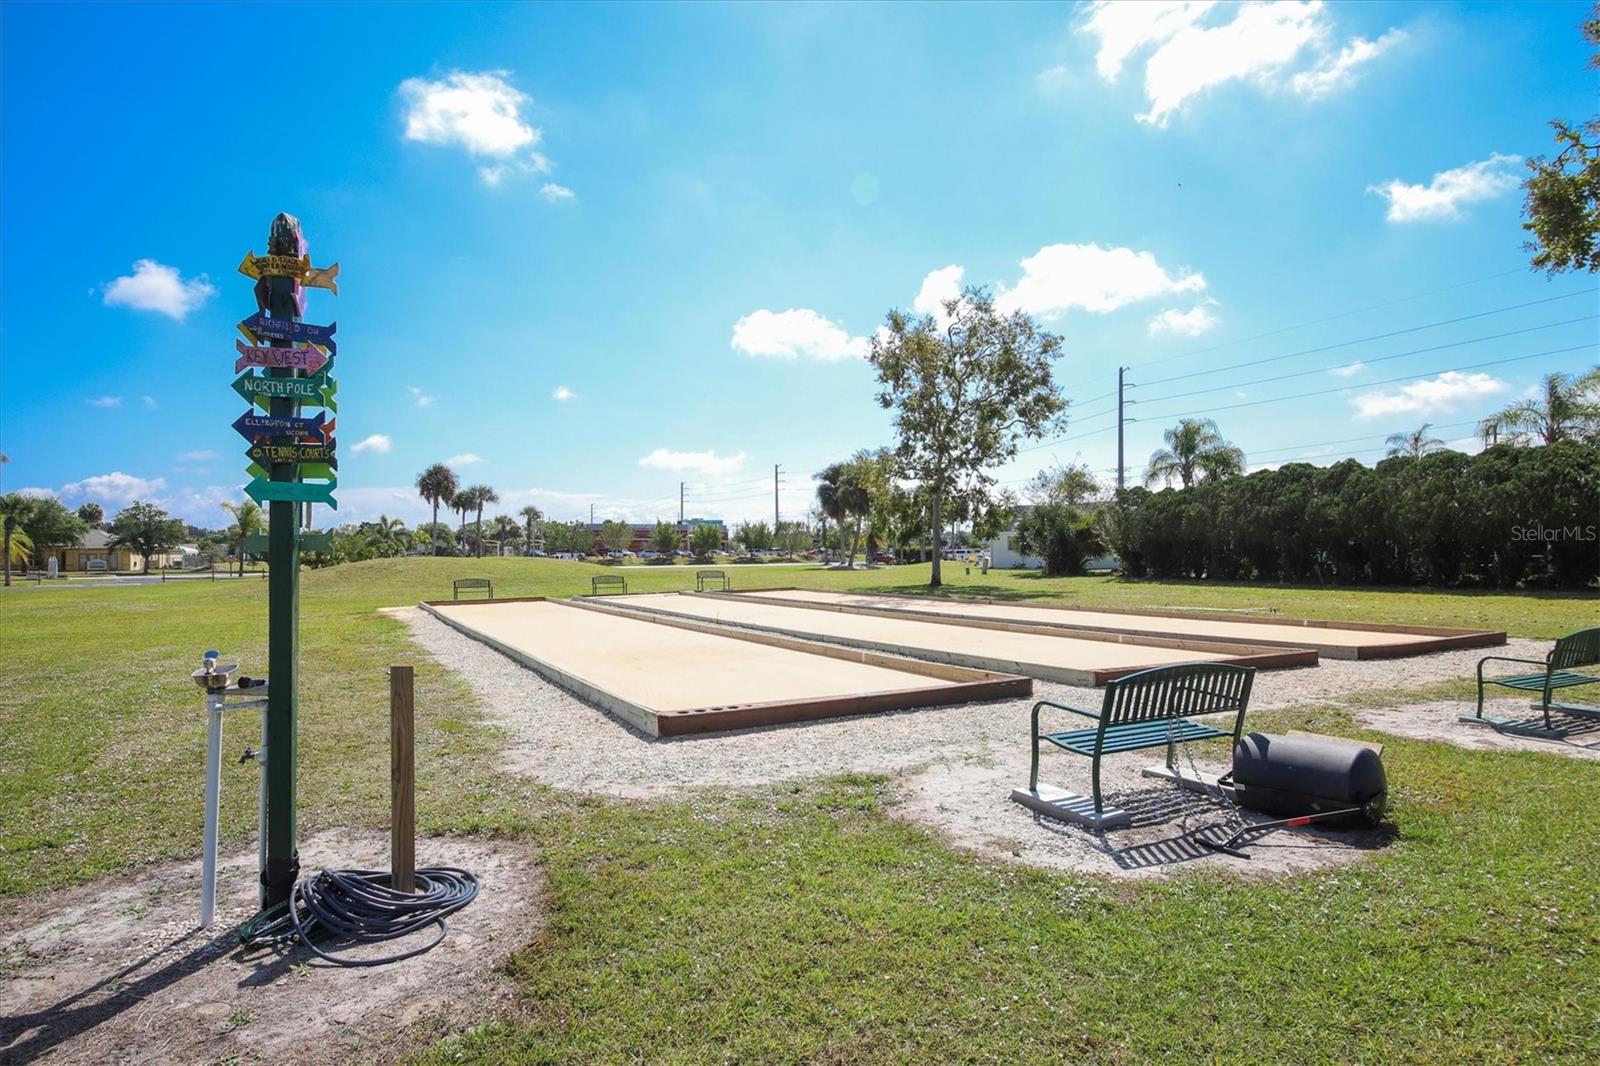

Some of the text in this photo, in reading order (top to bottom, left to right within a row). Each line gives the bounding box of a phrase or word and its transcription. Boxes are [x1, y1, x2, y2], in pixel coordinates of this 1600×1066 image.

[307, 326, 319, 336] OH
[246, 349, 309, 366] KEY WEST
[244, 379, 283, 393] NORTH
[286, 382, 315, 396] POLE
[245, 417, 291, 428] ELLINGTON
[262, 445, 330, 459] TENNIS COURTS
